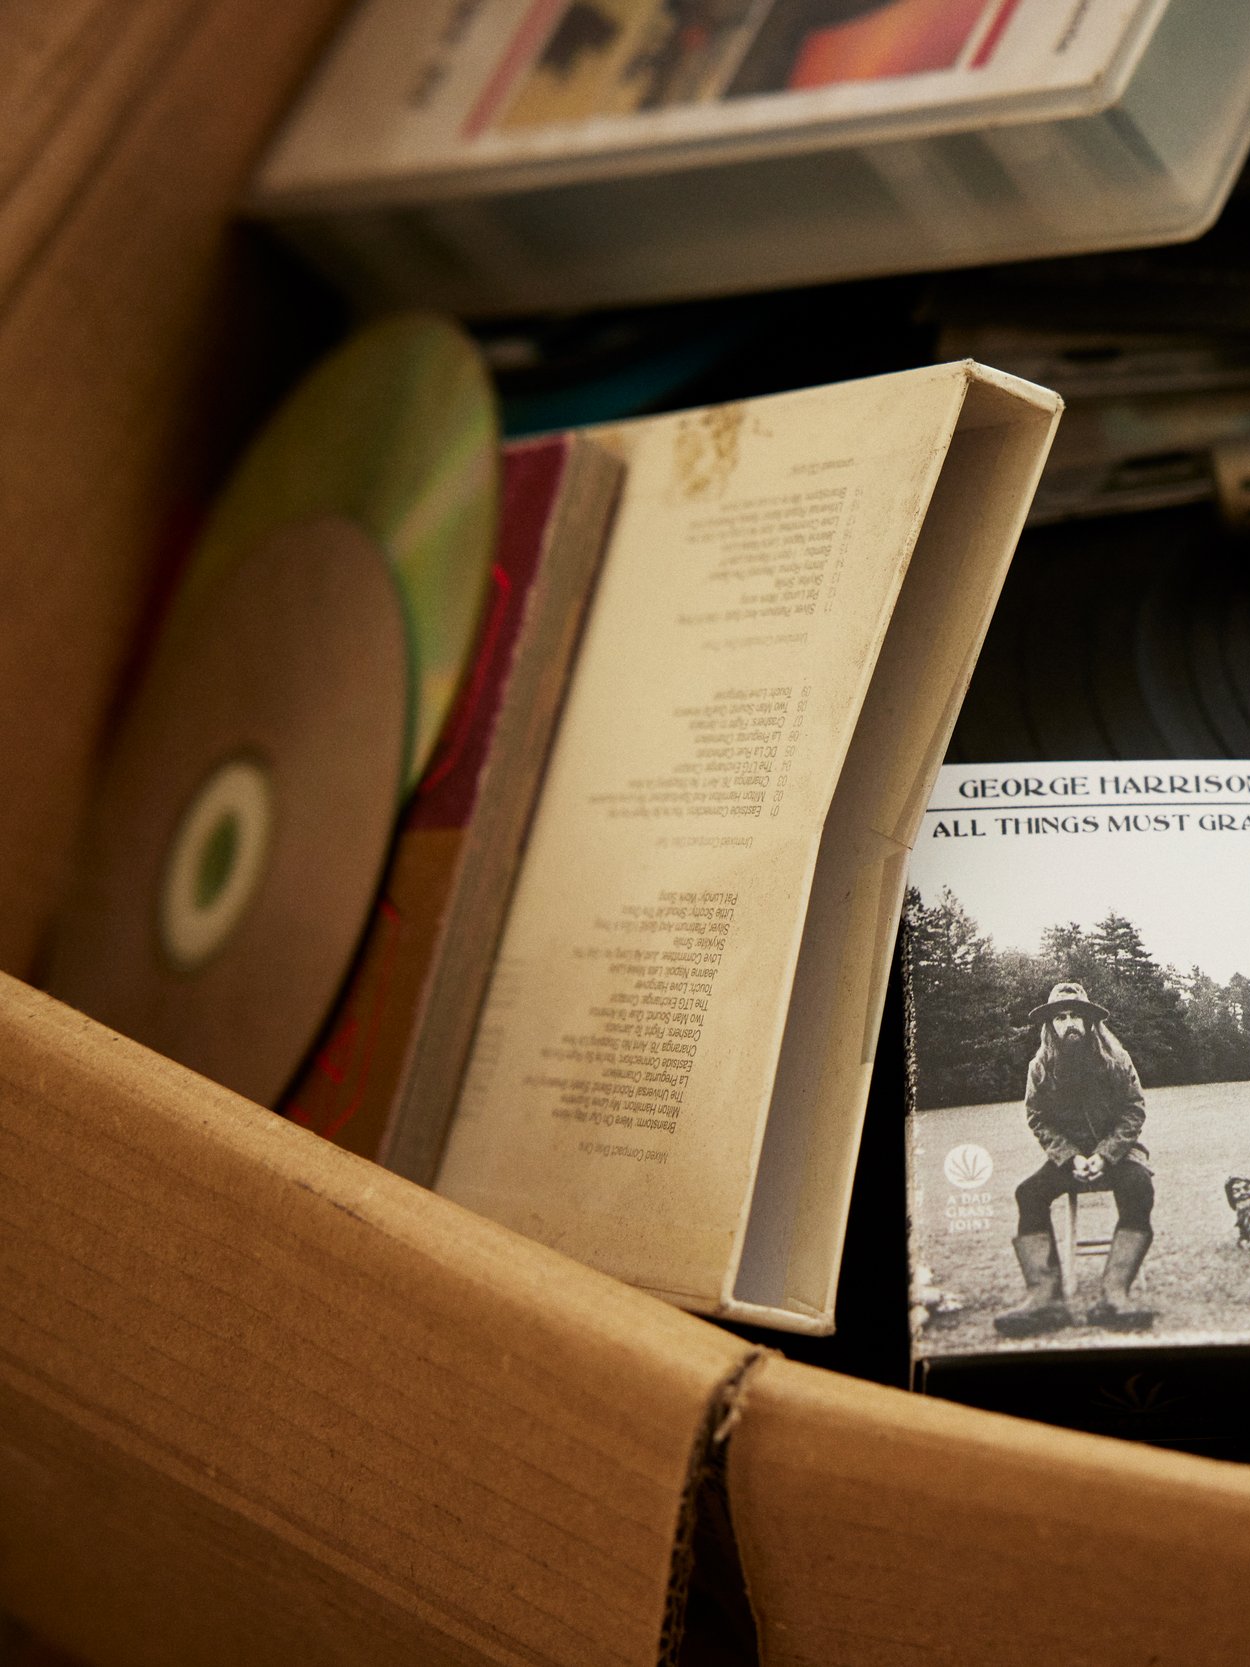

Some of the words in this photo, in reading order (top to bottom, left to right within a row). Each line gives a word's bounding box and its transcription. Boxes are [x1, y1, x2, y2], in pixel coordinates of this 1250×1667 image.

[958, 775, 1091, 800] GEORGE
[931, 818, 987, 839] ALL
[994, 814, 1100, 836] THINGS
[1107, 813, 1190, 834] MUST
[671, 1011, 689, 1025] Man
[688, 1012, 705, 1027] Two
[678, 1074, 689, 1088] La
[634, 1085, 669, 1102] Universal
[669, 1089, 684, 1103] The
[946, 1195, 957, 1206] A
[961, 1192, 992, 1205] DAD
[945, 1205, 994, 1218] GRASS
[948, 1218, 991, 1233] JOINT
